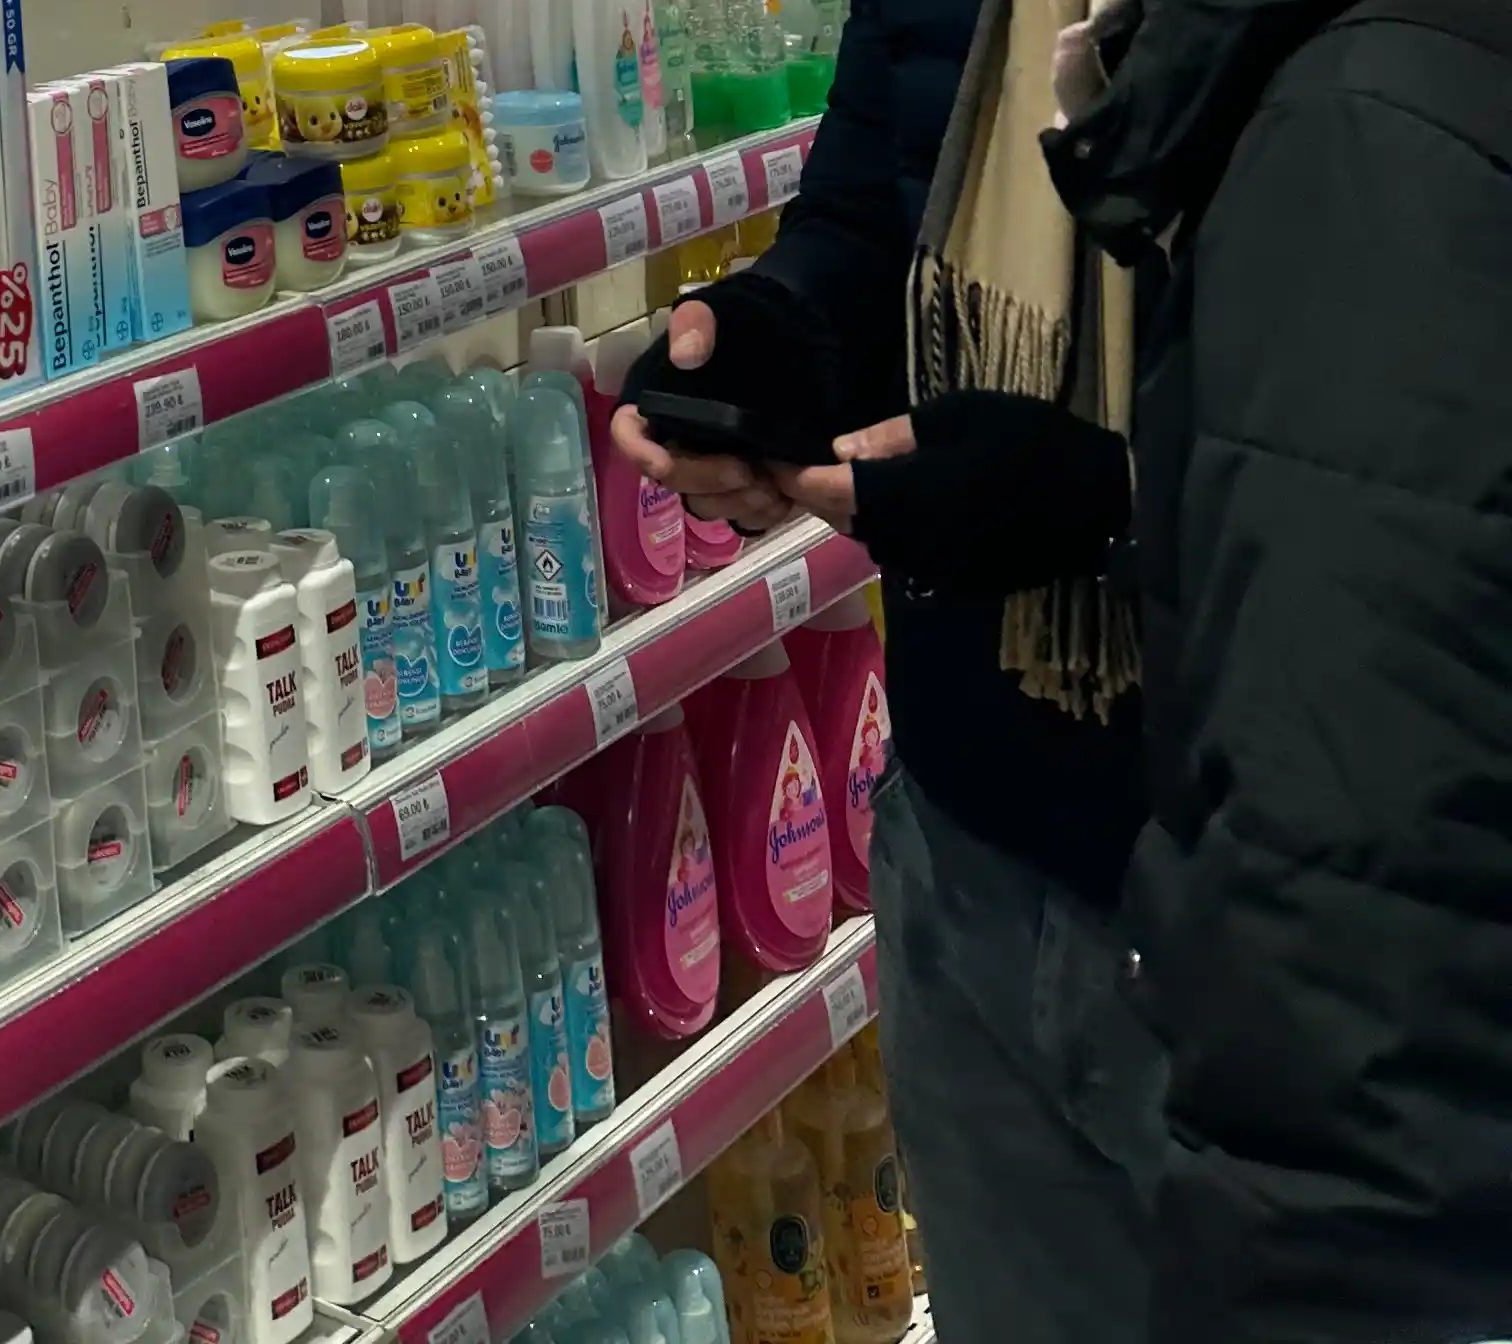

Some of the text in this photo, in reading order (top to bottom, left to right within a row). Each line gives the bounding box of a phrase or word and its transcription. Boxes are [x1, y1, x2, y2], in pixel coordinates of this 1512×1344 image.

[6, 9, 16, 30] 50
[7, 31, 18, 57] GR
[184, 115, 213, 129] Vaseline
[129, 120, 147, 210] Bepanthol
[43, 178, 59, 237] Baby
[44, 242, 67, 371] Bepanthol
[335, 644, 358, 676] TALK
[267, 670, 297, 704] TALK
[406, 1101, 435, 1135] TALK
[351, 1147, 380, 1182] TALK
[266, 1182, 297, 1217] TALK
